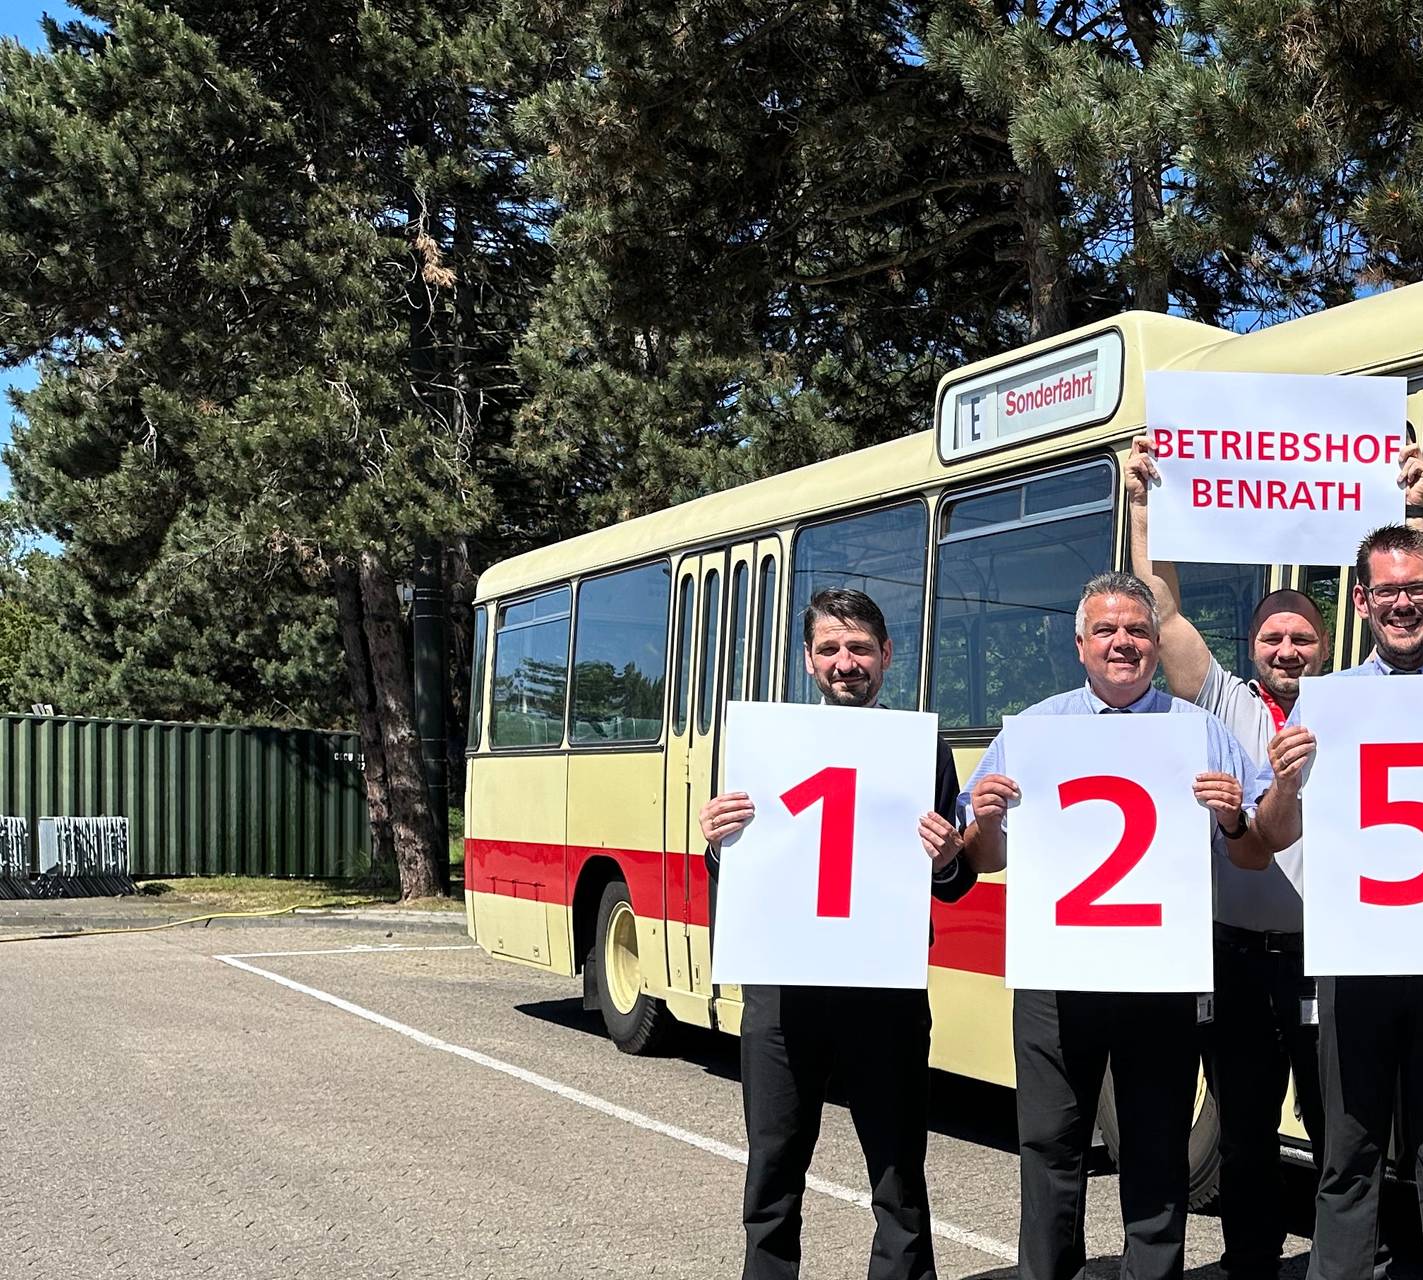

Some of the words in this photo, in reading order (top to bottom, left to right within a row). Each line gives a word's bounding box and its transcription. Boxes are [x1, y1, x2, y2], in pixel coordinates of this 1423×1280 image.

[970, 396, 981, 442] E
[1006, 370, 1093, 417] Sonderfahrt
[1153, 428, 1401, 465] BETRIEBSHOF
[1191, 478, 1361, 512] BENRATH
[779, 766, 857, 918] 1
[1055, 775, 1162, 927] 2
